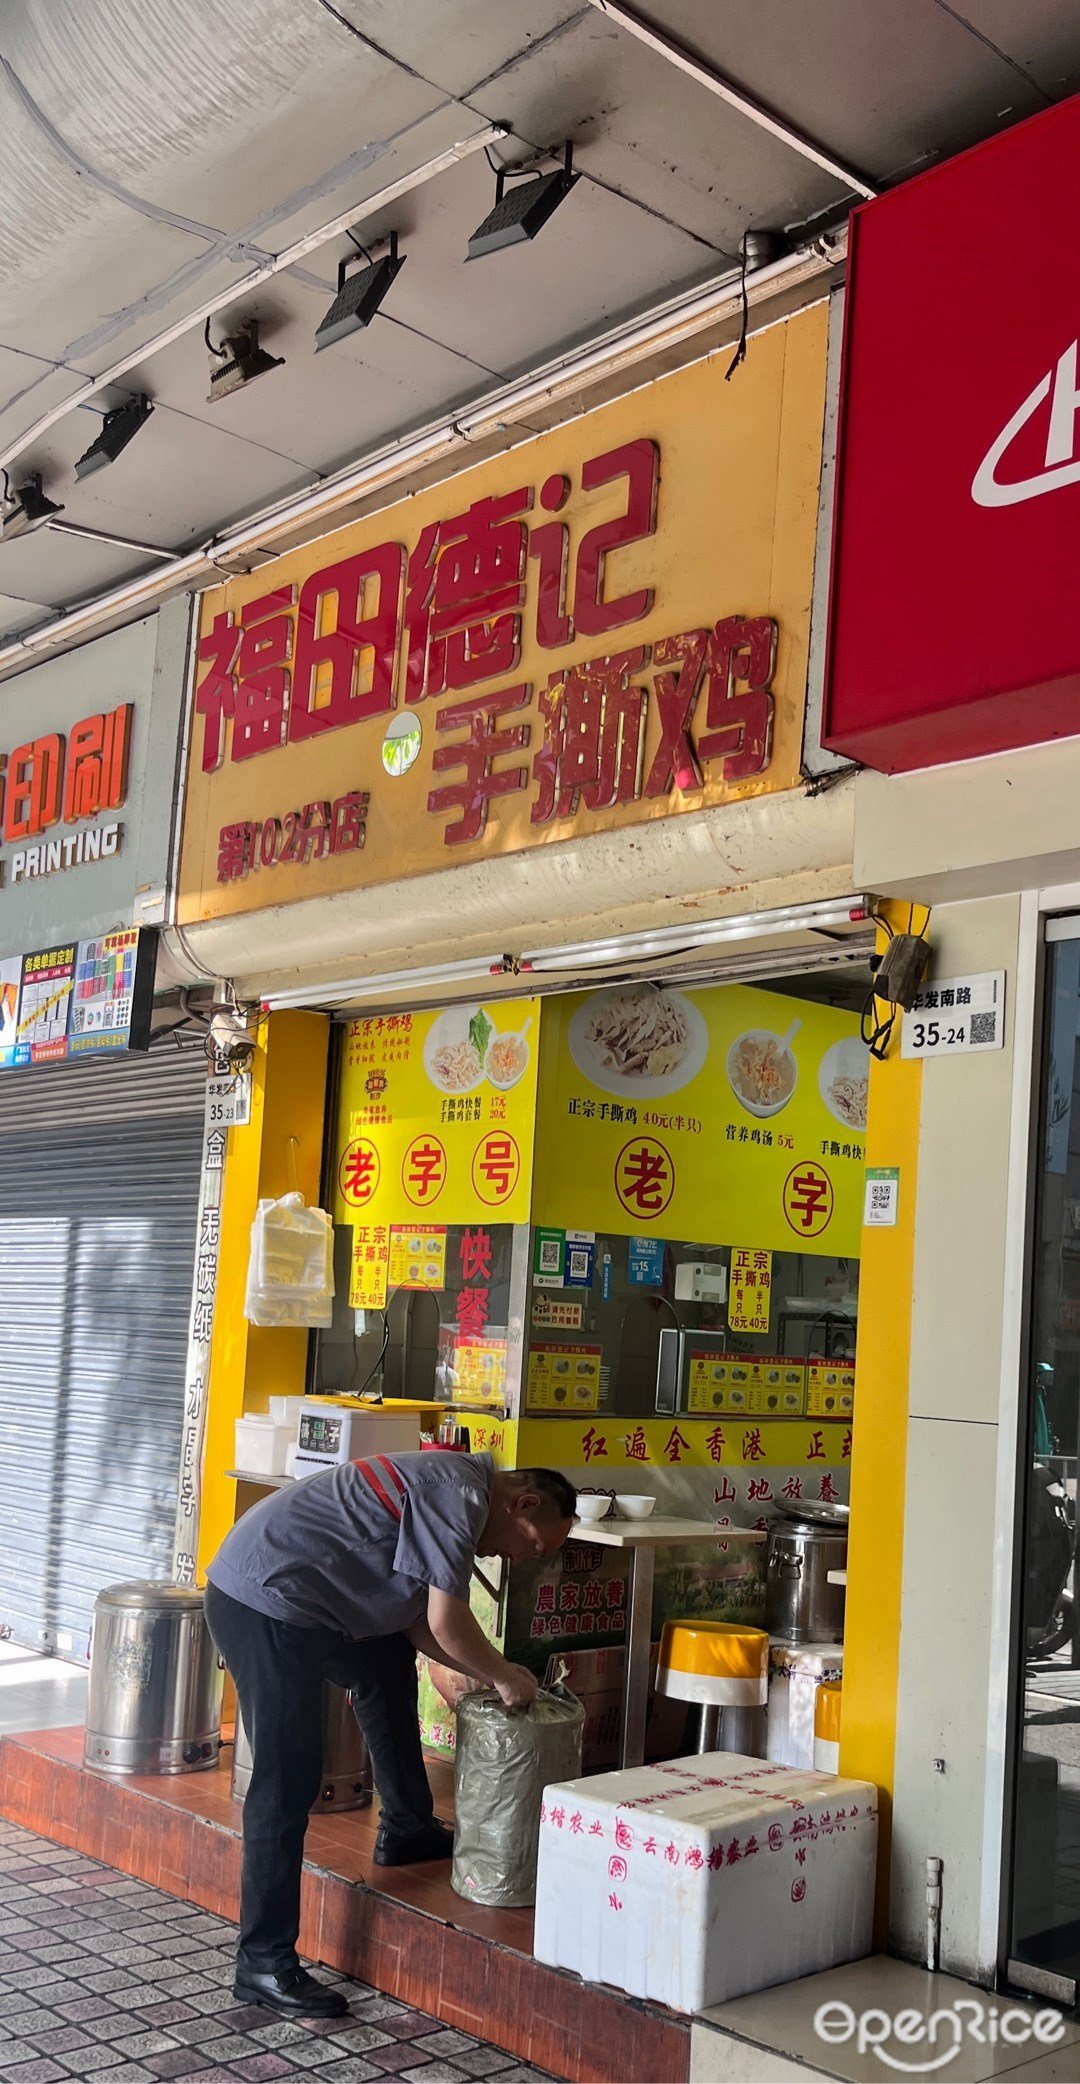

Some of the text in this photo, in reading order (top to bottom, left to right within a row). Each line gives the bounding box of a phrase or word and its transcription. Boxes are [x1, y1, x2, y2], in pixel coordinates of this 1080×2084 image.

[197, 438, 661, 774] 福田德记
[428, 614, 778, 845] 手撕鸡
[0, 703, 133, 842] 印刷
[216, 791, 370, 883] 第102分店
[11, 822, 121, 882] PRINTING
[25, 947, 75, 973] 各类单据定制
[911, 987, 972, 1012] 华发南路
[350, 1014, 413, 1037] 正宗手撕鸡
[912, 1022, 965, 1048] 35-24
[208, 1084, 237, 1095] 华发
[210, 1104, 235, 1120] 35-23
[567, 1098, 638, 1126] 正宗手撕鸡
[725, 1124, 795, 1149] 营养鸡汤 5元
[819, 1140, 866, 1161] 手撕鸡快
[344, 1141, 515, 1198] 老 字 号
[622, 1148, 828, 1227] 老 字
[357, 1226, 387, 1244] 正宗
[353, 1246, 388, 1263] 手撕鸡
[735, 1251, 768, 1270] 正宗
[455, 1227, 492, 1340] 快餐
[731, 1269, 771, 1289] 手撕鸡
[350, 1292, 384, 1306] 78元 40元
[735, 1289, 764, 1315] 每只 半只
[730, 1316, 768, 1330] 78元 40元
[474, 1427, 505, 1453] 深圳
[581, 1425, 768, 1464] 红遍全香港
[714, 1473, 840, 1504] 山地放養
[562, 1548, 603, 1573] 制作
[536, 1580, 625, 1613] 農家放養
[418, 1720, 457, 1747] 深圳
